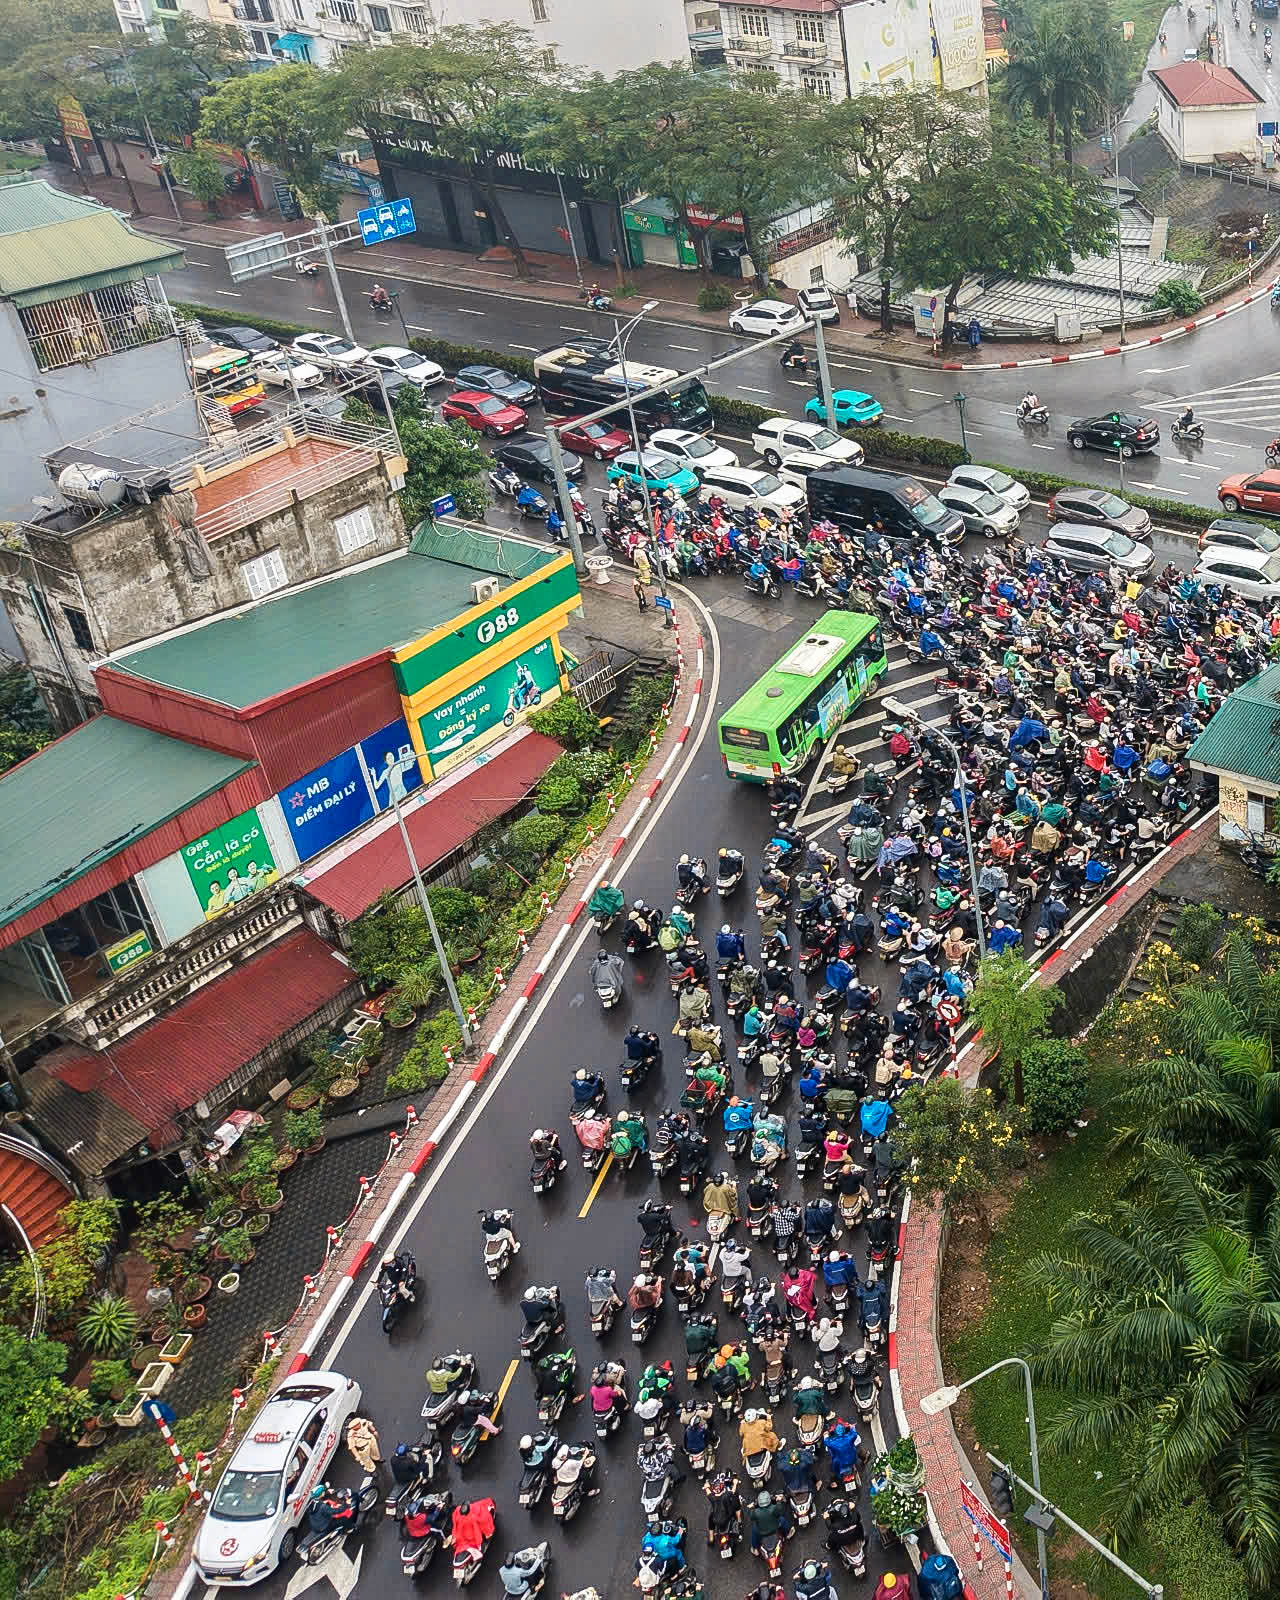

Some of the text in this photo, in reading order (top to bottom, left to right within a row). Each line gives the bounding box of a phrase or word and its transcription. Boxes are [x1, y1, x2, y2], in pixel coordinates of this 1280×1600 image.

[476, 608, 520, 643] F88
[433, 684, 486, 721] Vay nhanh
[479, 703, 491, 714] xe
[306, 777, 330, 799] MB
[323, 791, 344, 809] ĐẠI
[343, 780, 357, 797] LÝ
[184, 839, 210, 857] F88
[193, 827, 260, 870] Cần là có
